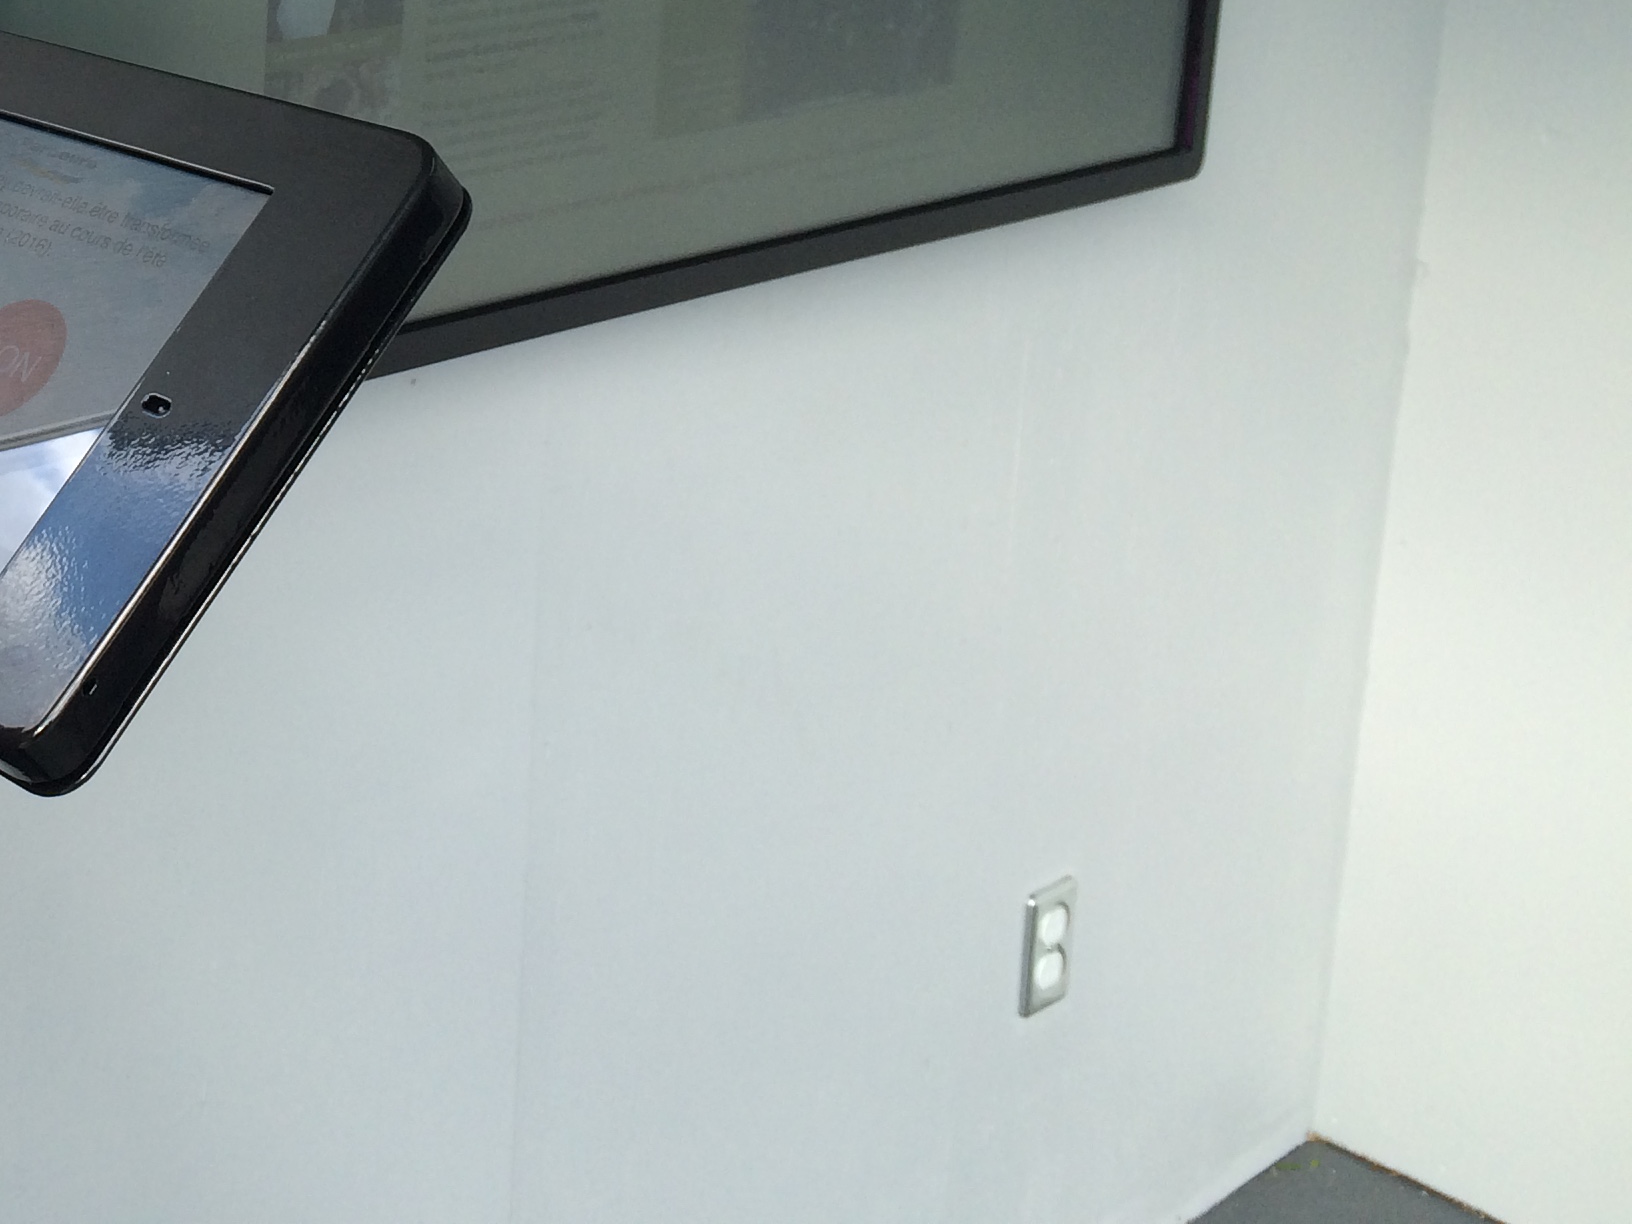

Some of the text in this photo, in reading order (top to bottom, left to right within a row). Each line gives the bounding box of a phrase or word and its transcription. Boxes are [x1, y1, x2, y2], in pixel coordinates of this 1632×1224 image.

[48, 218, 68, 236] au
[72, 225, 115, 250] cours
[115, 235, 134, 256] de
